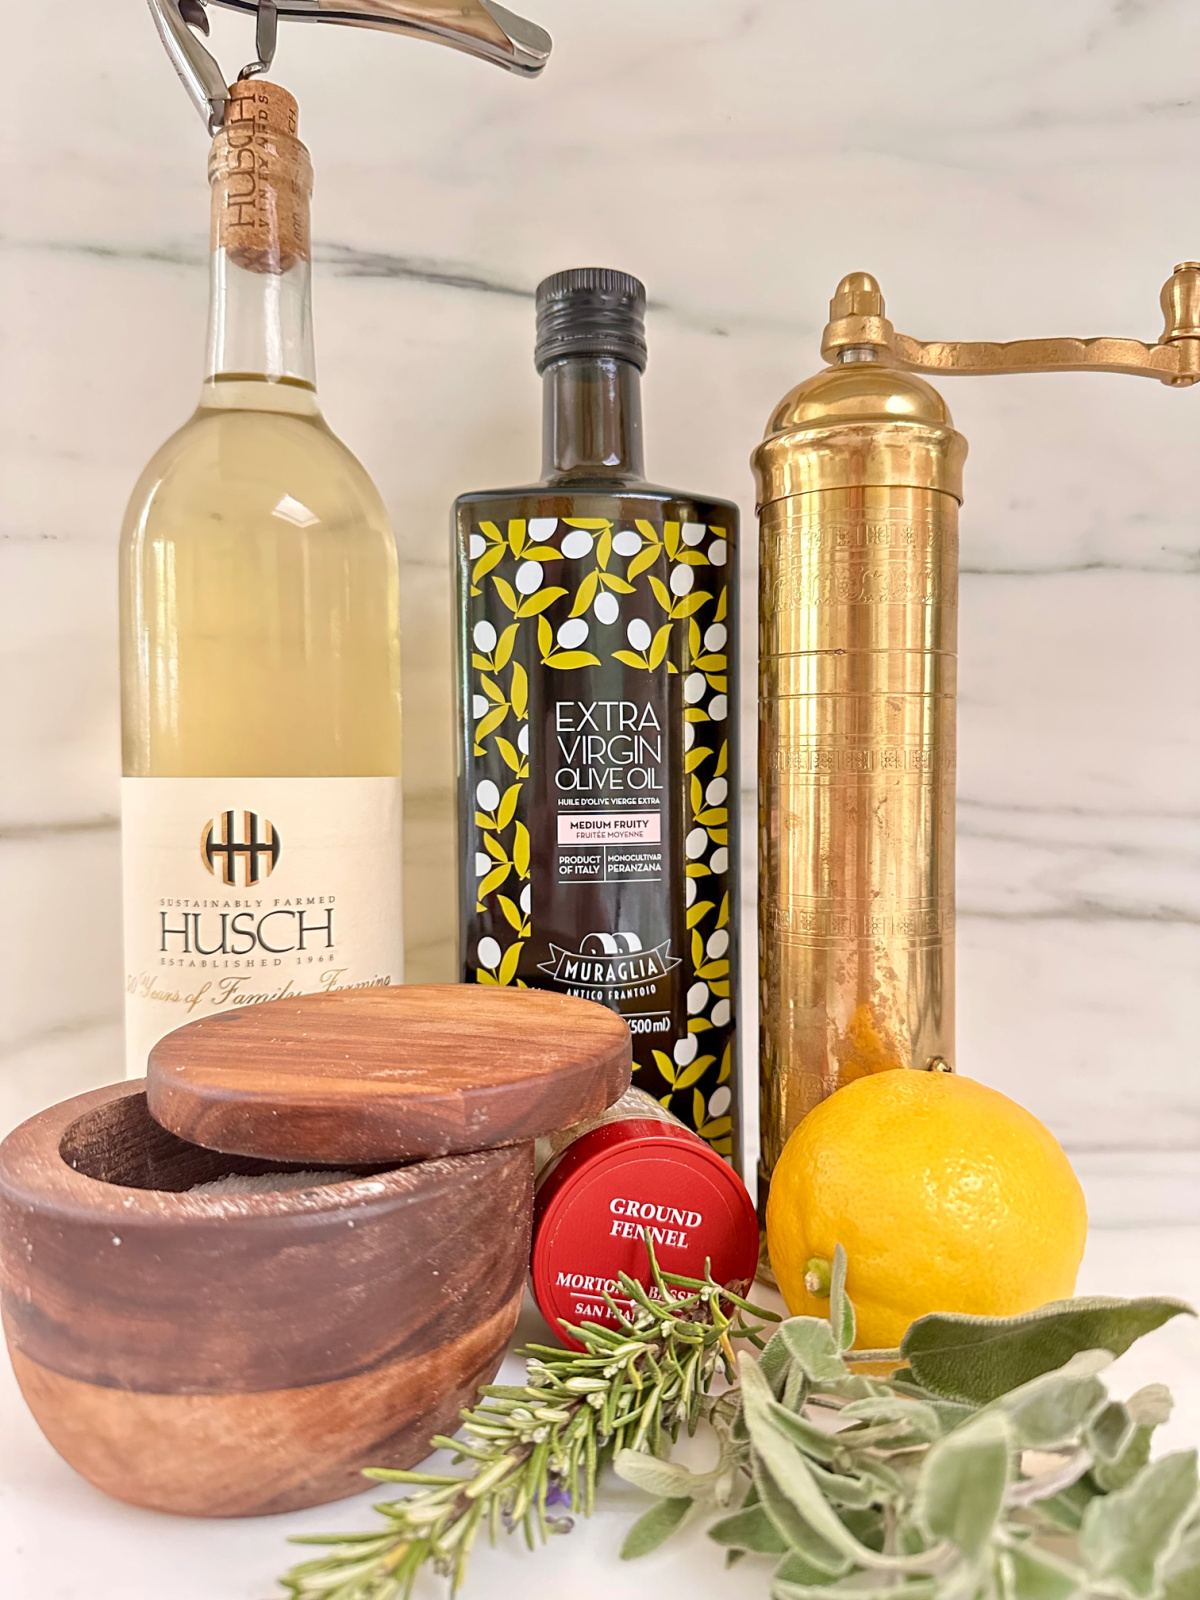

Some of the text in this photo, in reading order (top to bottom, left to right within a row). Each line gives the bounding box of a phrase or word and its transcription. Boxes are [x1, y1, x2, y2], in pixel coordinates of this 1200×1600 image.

[227, 95, 256, 230] HUSCH
[555, 701, 661, 732] EXTRA
[557, 735, 662, 765] VIRGIN
[555, 767, 663, 791] OLIVE OIL
[557, 797, 661, 806] HUILE D'OLIVE VIERGE EXTRA
[570, 820, 649, 829] MEDIUM FRUITY
[576, 830, 644, 839] FRUITÉE MOYENNE
[559, 855, 601, 864] PRODUCT
[607, 853, 662, 862] MONOCULTIVAR
[558, 865, 600, 875] OF ITALY
[607, 863, 662, 873] PERANZANA
[159, 895, 337, 908] SUSTAINABLY FARMED
[159, 908, 335, 956] HUSCH
[160, 953, 336, 968] ESTABLISHED 1968
[564, 956, 659, 982] MURAGLIA
[184, 981, 213, 1013] of
[566, 984, 657, 1001] ANTICO FRANTOIO
[609, 1198, 702, 1228] GROUND
[609, 1219, 689, 1249] FENNEL
[575, 1302, 604, 1317] SAN
